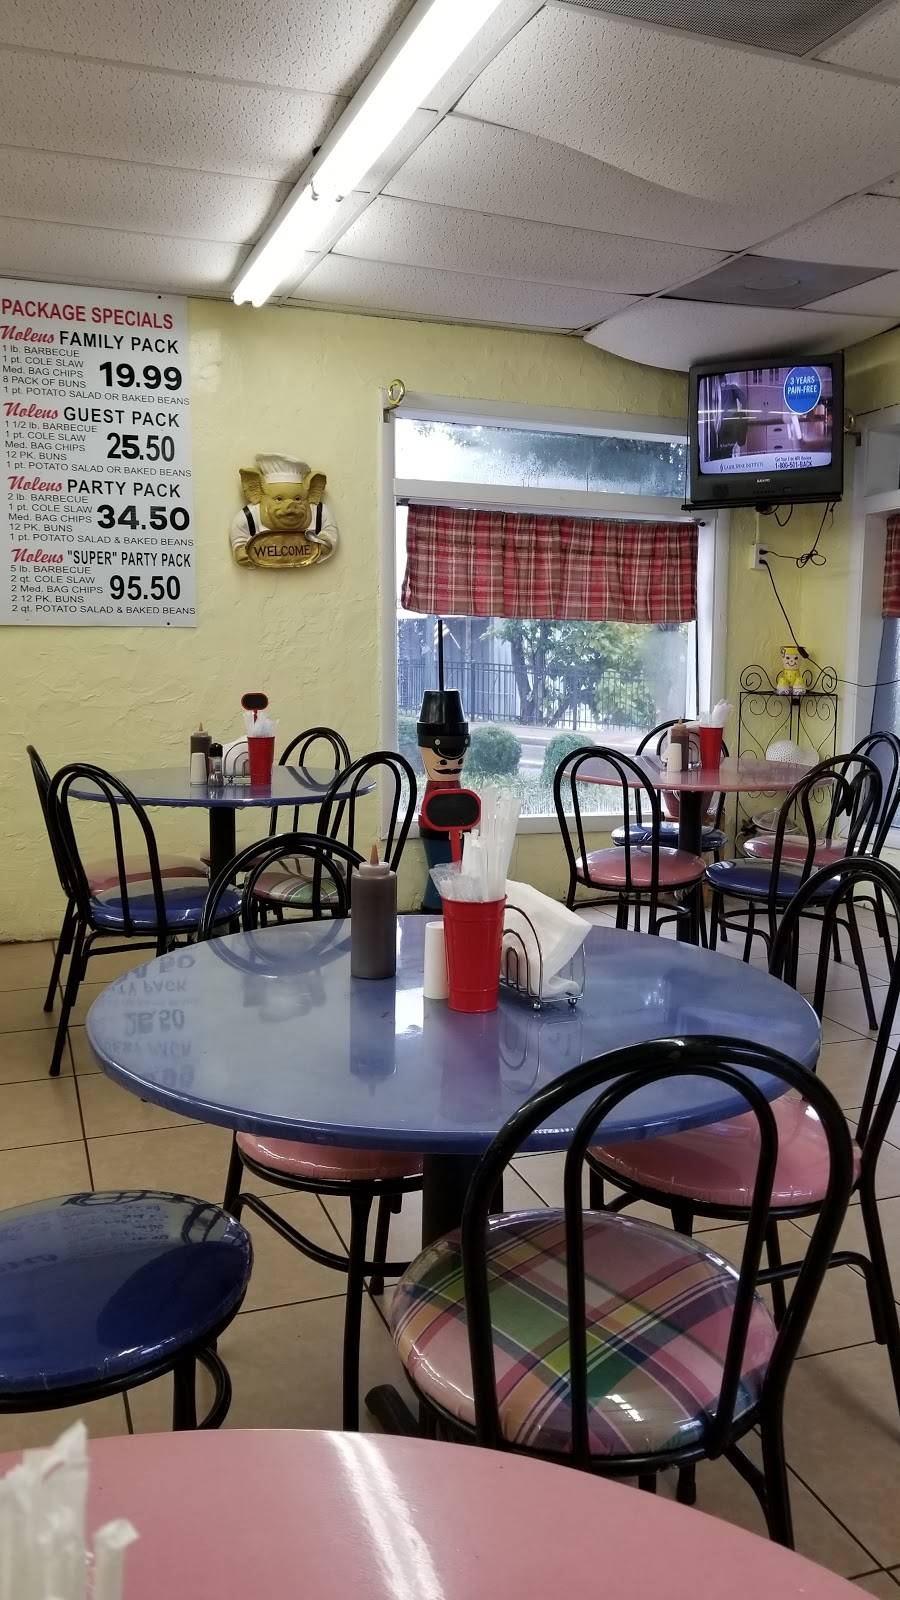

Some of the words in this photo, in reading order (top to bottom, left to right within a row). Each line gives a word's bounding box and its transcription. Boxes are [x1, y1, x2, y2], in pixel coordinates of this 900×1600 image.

[2, 299, 86, 322] PACKAGE
[92, 307, 173, 329] SPECIALS
[0, 325, 54, 344] Nolens
[60, 331, 124, 350] FAMILY
[132, 337, 179, 354] PACK
[24, 346, 80, 358] BARBECUE
[25, 357, 52, 365] COLE
[56, 359, 84, 368] SLAW
[3, 366, 25, 374] Med.
[29, 367, 49, 376] BAG
[53, 369, 83, 378] CHIPS
[100, 361, 182, 391] 19.99
[12, 376, 38, 385] PACK
[59, 379, 86, 388] BUNS
[796, 376, 815, 384] YEARS
[788, 385, 817, 395] PAIN-FREE
[27, 388, 66, 397] POTATO
[69, 390, 102, 399] SALAD
[122, 394, 154, 403] BAKED
[158, 397, 190, 406] BEANS
[3, 402, 59, 420] Nolens
[64, 406, 124, 424] GUEST
[132, 411, 180, 428] PACK
[43, 422, 98, 432] BARBECUE
[28, 432, 55, 440] COLE
[58, 433, 86, 442] SLAW
[5, 441, 27, 449] Med.
[55, 443, 86, 452] CHIPS
[107, 432, 175, 462] 25.50
[29, 462, 68, 471] POTATO
[71, 464, 103, 473] SALAD
[124, 467, 156, 476] BAKED
[159, 468, 192, 477] BEANS
[8, 476, 65, 492] Nolens
[68, 479, 126, 496] PARTY
[134, 482, 181, 498] PACK
[31, 494, 89, 503] BARBECUE
[32, 504, 60, 512] COLE
[63, 505, 93, 513] SLAW
[60, 515, 92, 523] CHIPS
[97, 504, 190, 530] 34.50
[33, 534, 74, 542] POTATO
[78, 535, 111, 544] SALAD
[124, 536, 158, 545] BAKED
[161, 538, 194, 546] BEANS
[254, 544, 311, 557] WELCOME
[11, 548, 64, 564] Nolens
[67, 550, 117, 565] "SUPER"
[121, 552, 157, 567] PARTY
[161, 553, 191, 568] PACK
[34, 565, 91, 574] BARBECUE
[35, 575, 63, 583] COLE
[20, 585, 43, 593] Med.
[47, 585, 69, 593] BAG
[71, 586, 103, 594] CHIPS
[109, 575, 181, 601] 95.50
[11, 595, 17, 603] 2
[80, 606, 113, 614] SALAD
[162, 607, 196, 615] BEANS
